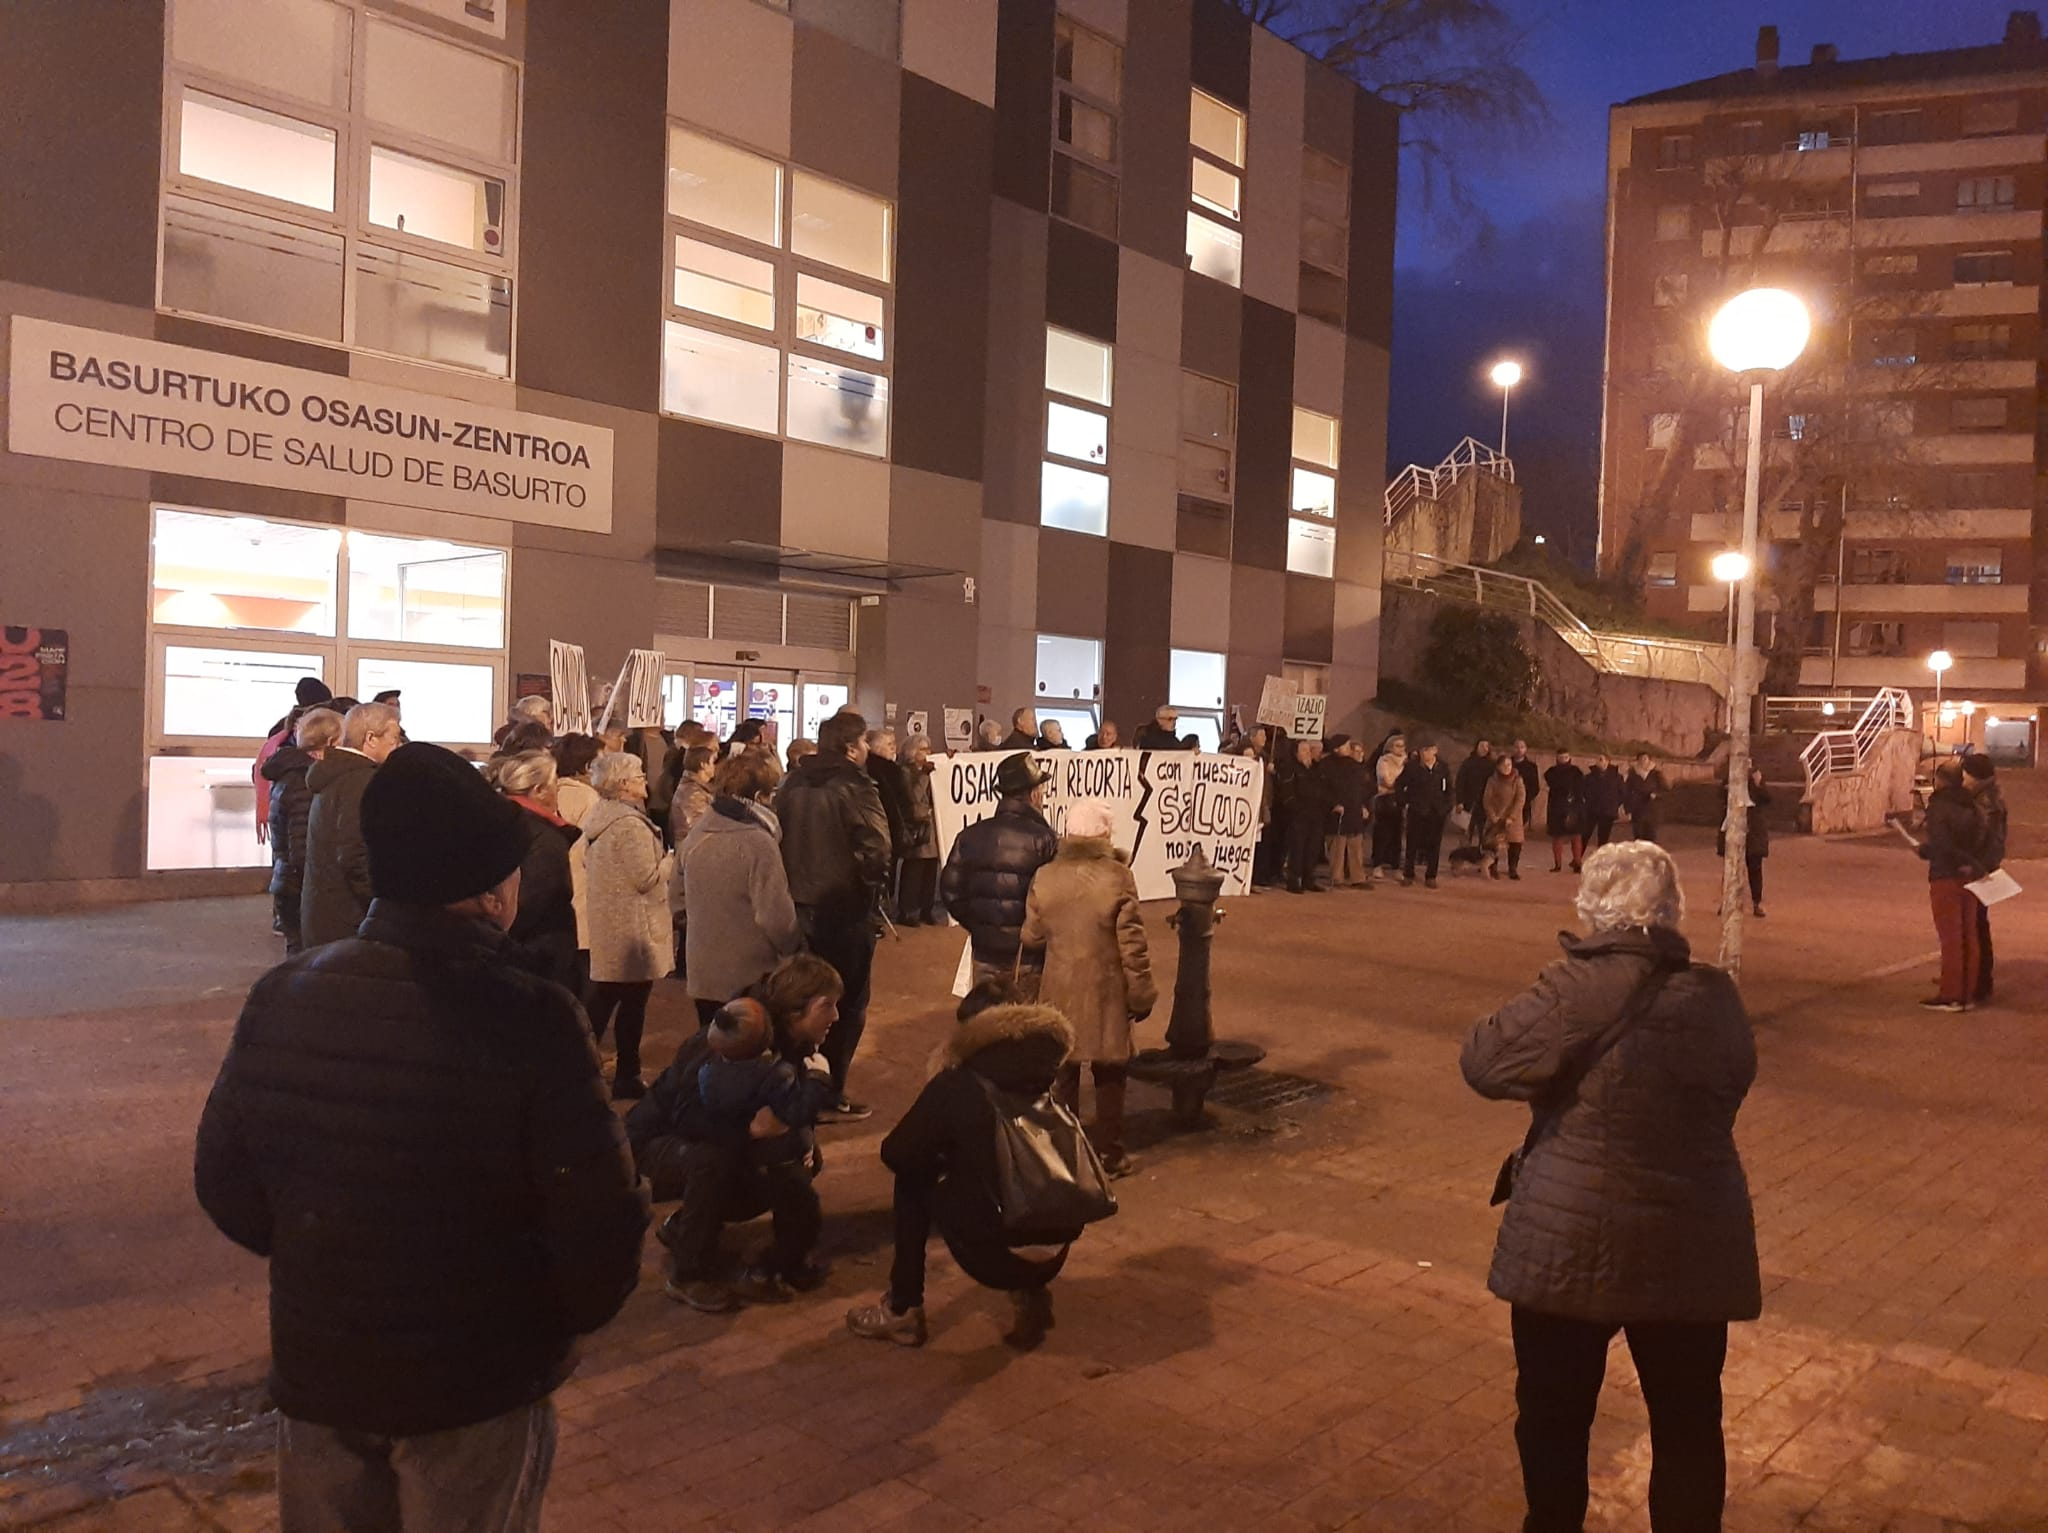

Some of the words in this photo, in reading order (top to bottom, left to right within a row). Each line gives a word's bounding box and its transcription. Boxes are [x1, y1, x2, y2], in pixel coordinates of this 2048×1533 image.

[50, 350, 291, 417] BASURTUKO
[301, 395, 590, 469] OSASUN-ZENTROA
[55, 403, 214, 451] CENTRO
[227, 429, 273, 461] DE
[284, 438, 393, 478] SALUD
[403, 457, 444, 487] DE
[453, 465, 587, 508] BASURTO
[1294, 717, 1319, 735] EZ
[1067, 757, 1132, 800] RECORTA
[1156, 761, 1182, 782] con
[1192, 758, 1250, 788] nuestra
